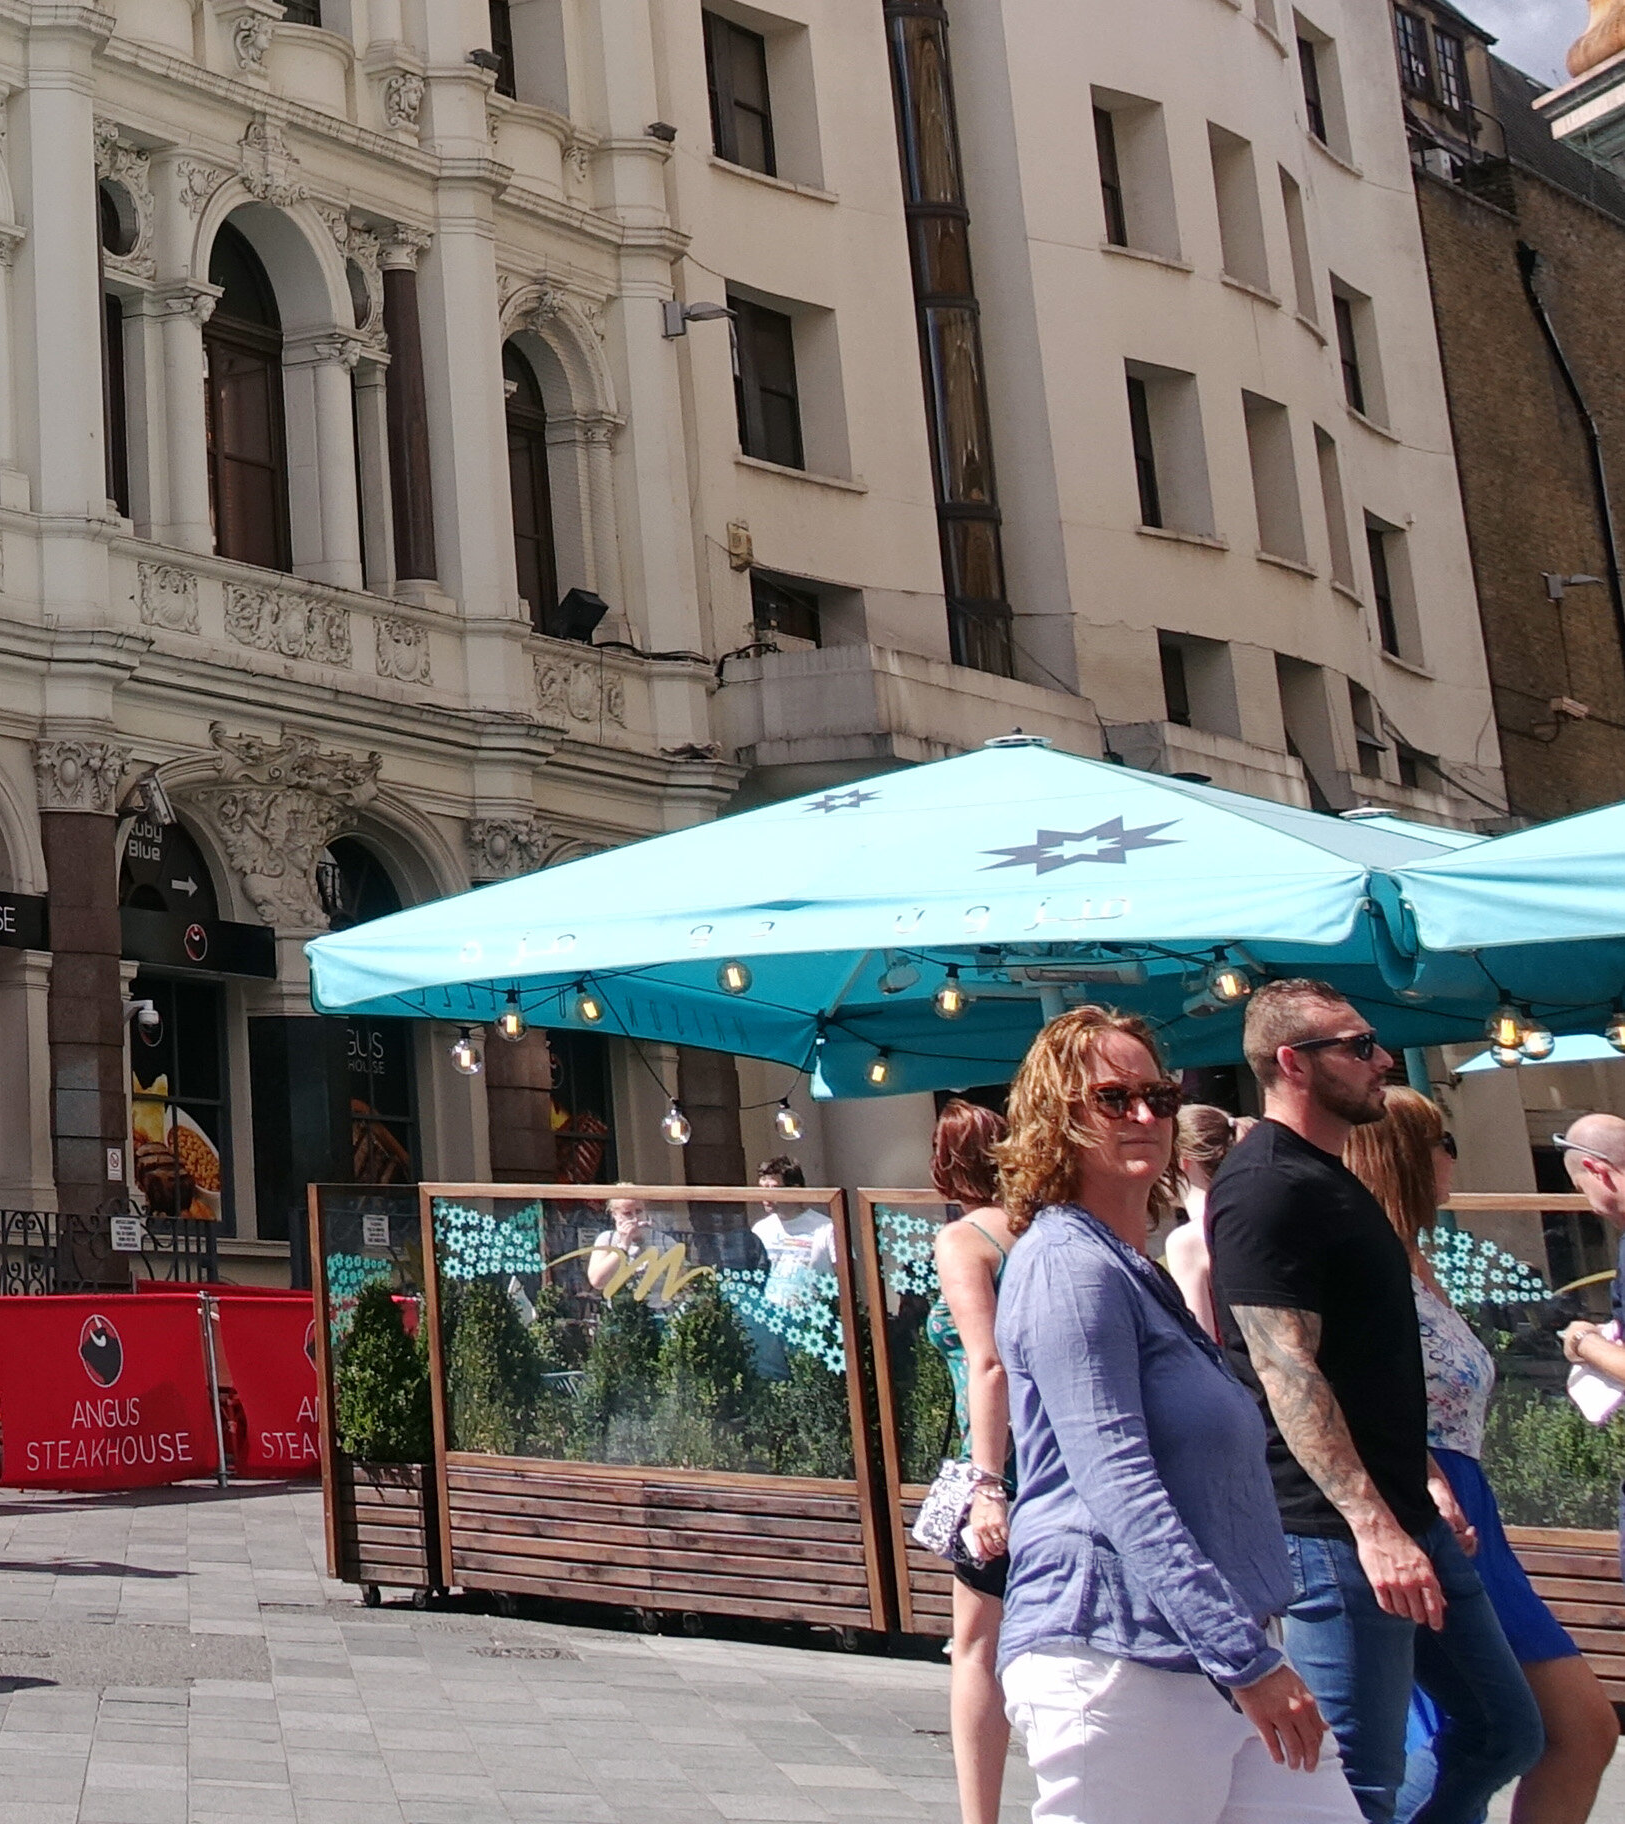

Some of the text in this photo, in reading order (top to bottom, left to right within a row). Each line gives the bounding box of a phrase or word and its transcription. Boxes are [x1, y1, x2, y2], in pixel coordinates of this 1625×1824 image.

[131, 821, 163, 844] uby
[128, 839, 162, 862] Blue
[72, 1396, 140, 1430] ANGUS
[26, 1431, 193, 1473] STEAKHOUSE
